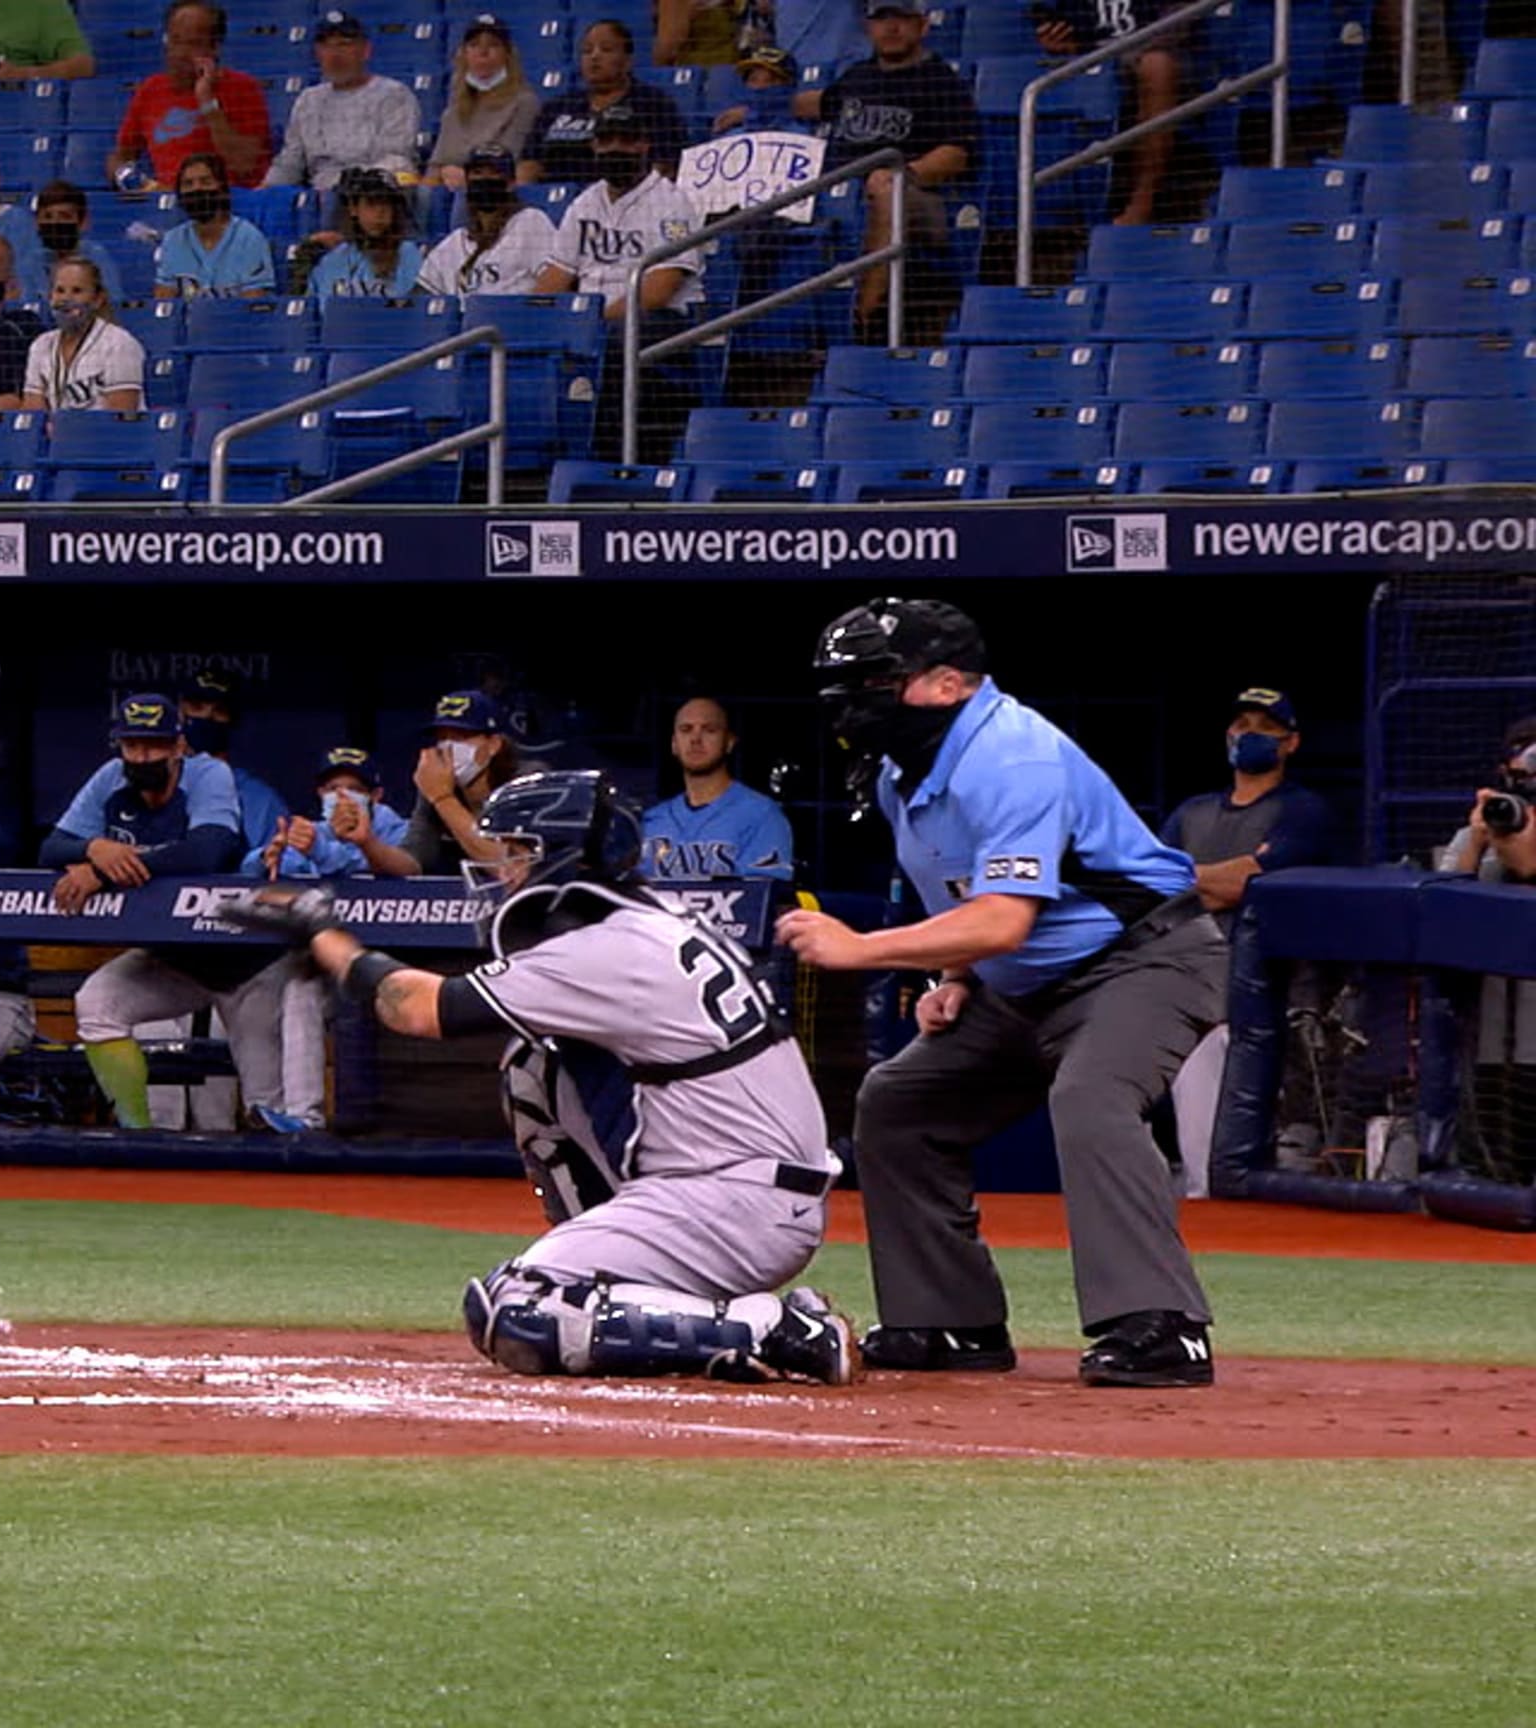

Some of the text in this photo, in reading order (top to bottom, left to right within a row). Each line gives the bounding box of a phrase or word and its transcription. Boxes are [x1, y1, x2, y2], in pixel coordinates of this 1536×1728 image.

[50, 532, 383, 572] neweracap.com
[606, 528, 958, 570] neweracap.com
[332, 898, 498, 924] RAYSBASEBA
